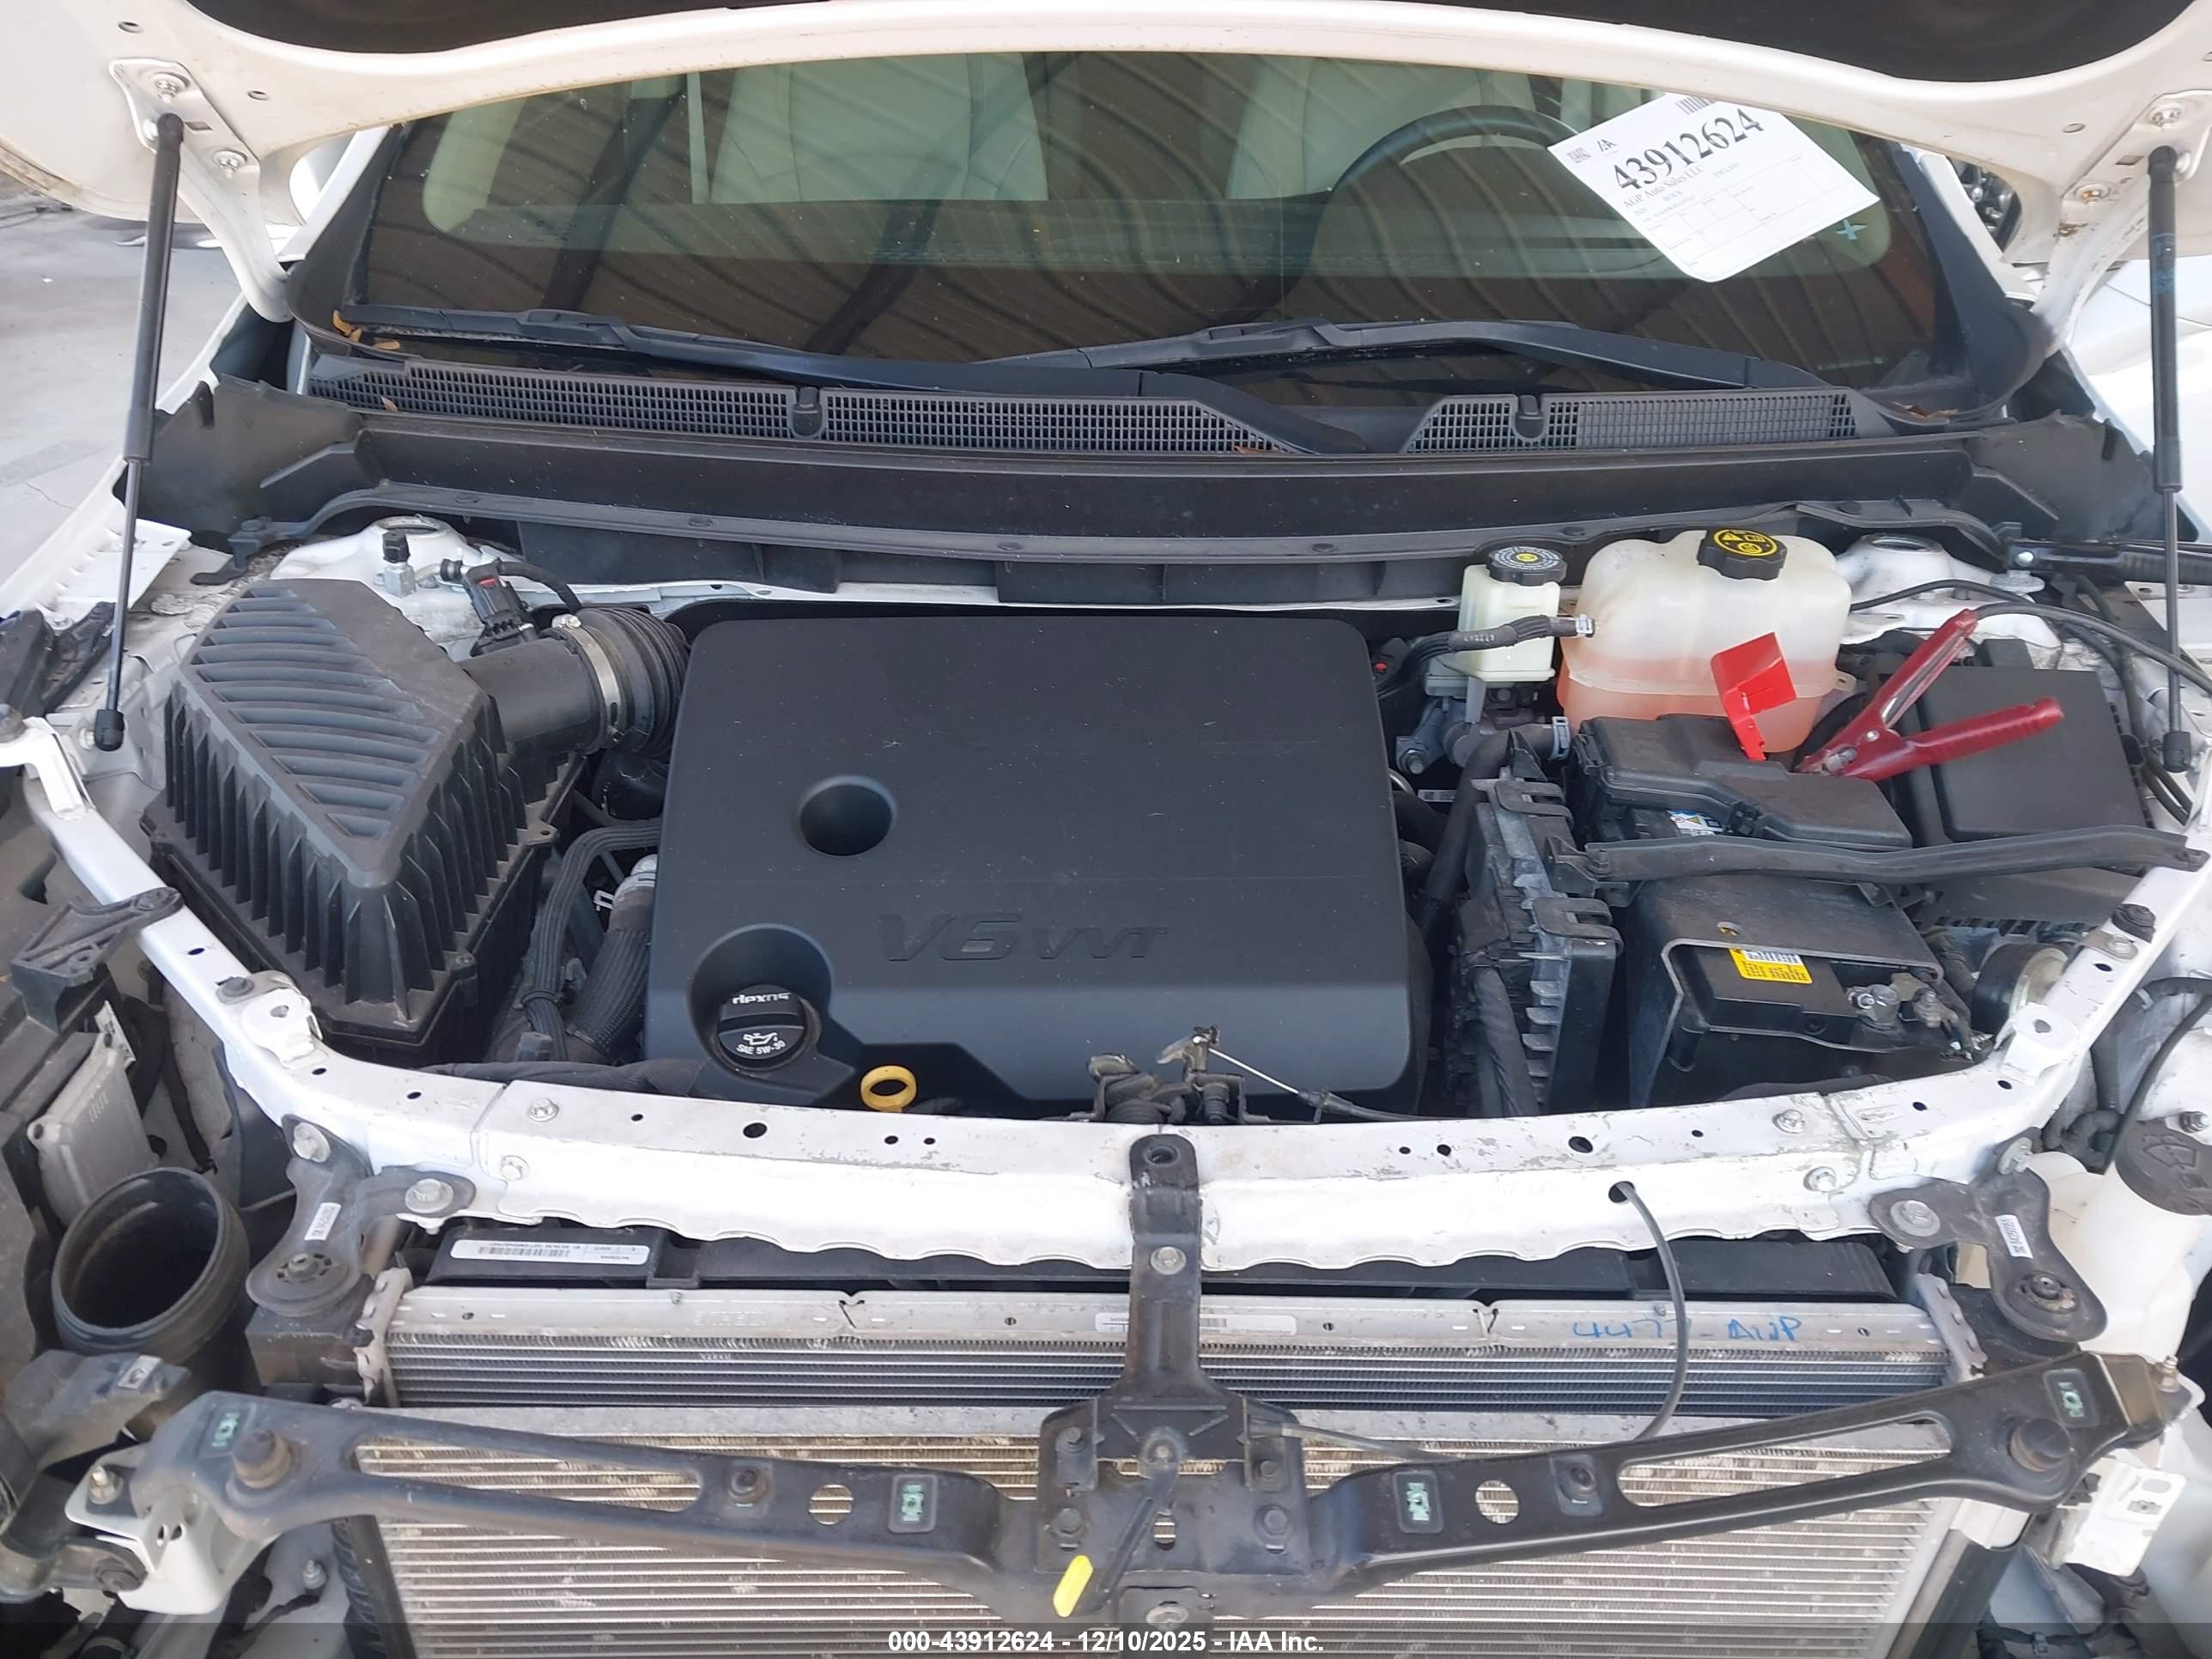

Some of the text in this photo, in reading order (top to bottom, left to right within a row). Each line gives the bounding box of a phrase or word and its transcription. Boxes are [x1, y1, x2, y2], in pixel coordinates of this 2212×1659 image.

[1613, 109, 1764, 190] 43912624
[1644, 184, 1665, 199] Auto
[1664, 174, 1686, 190] Sales
[1684, 165, 1705, 179] LLC
[878, 913, 1169, 962] V6 VVT
[736, 1040, 786, 1055] SAE 5W-30
